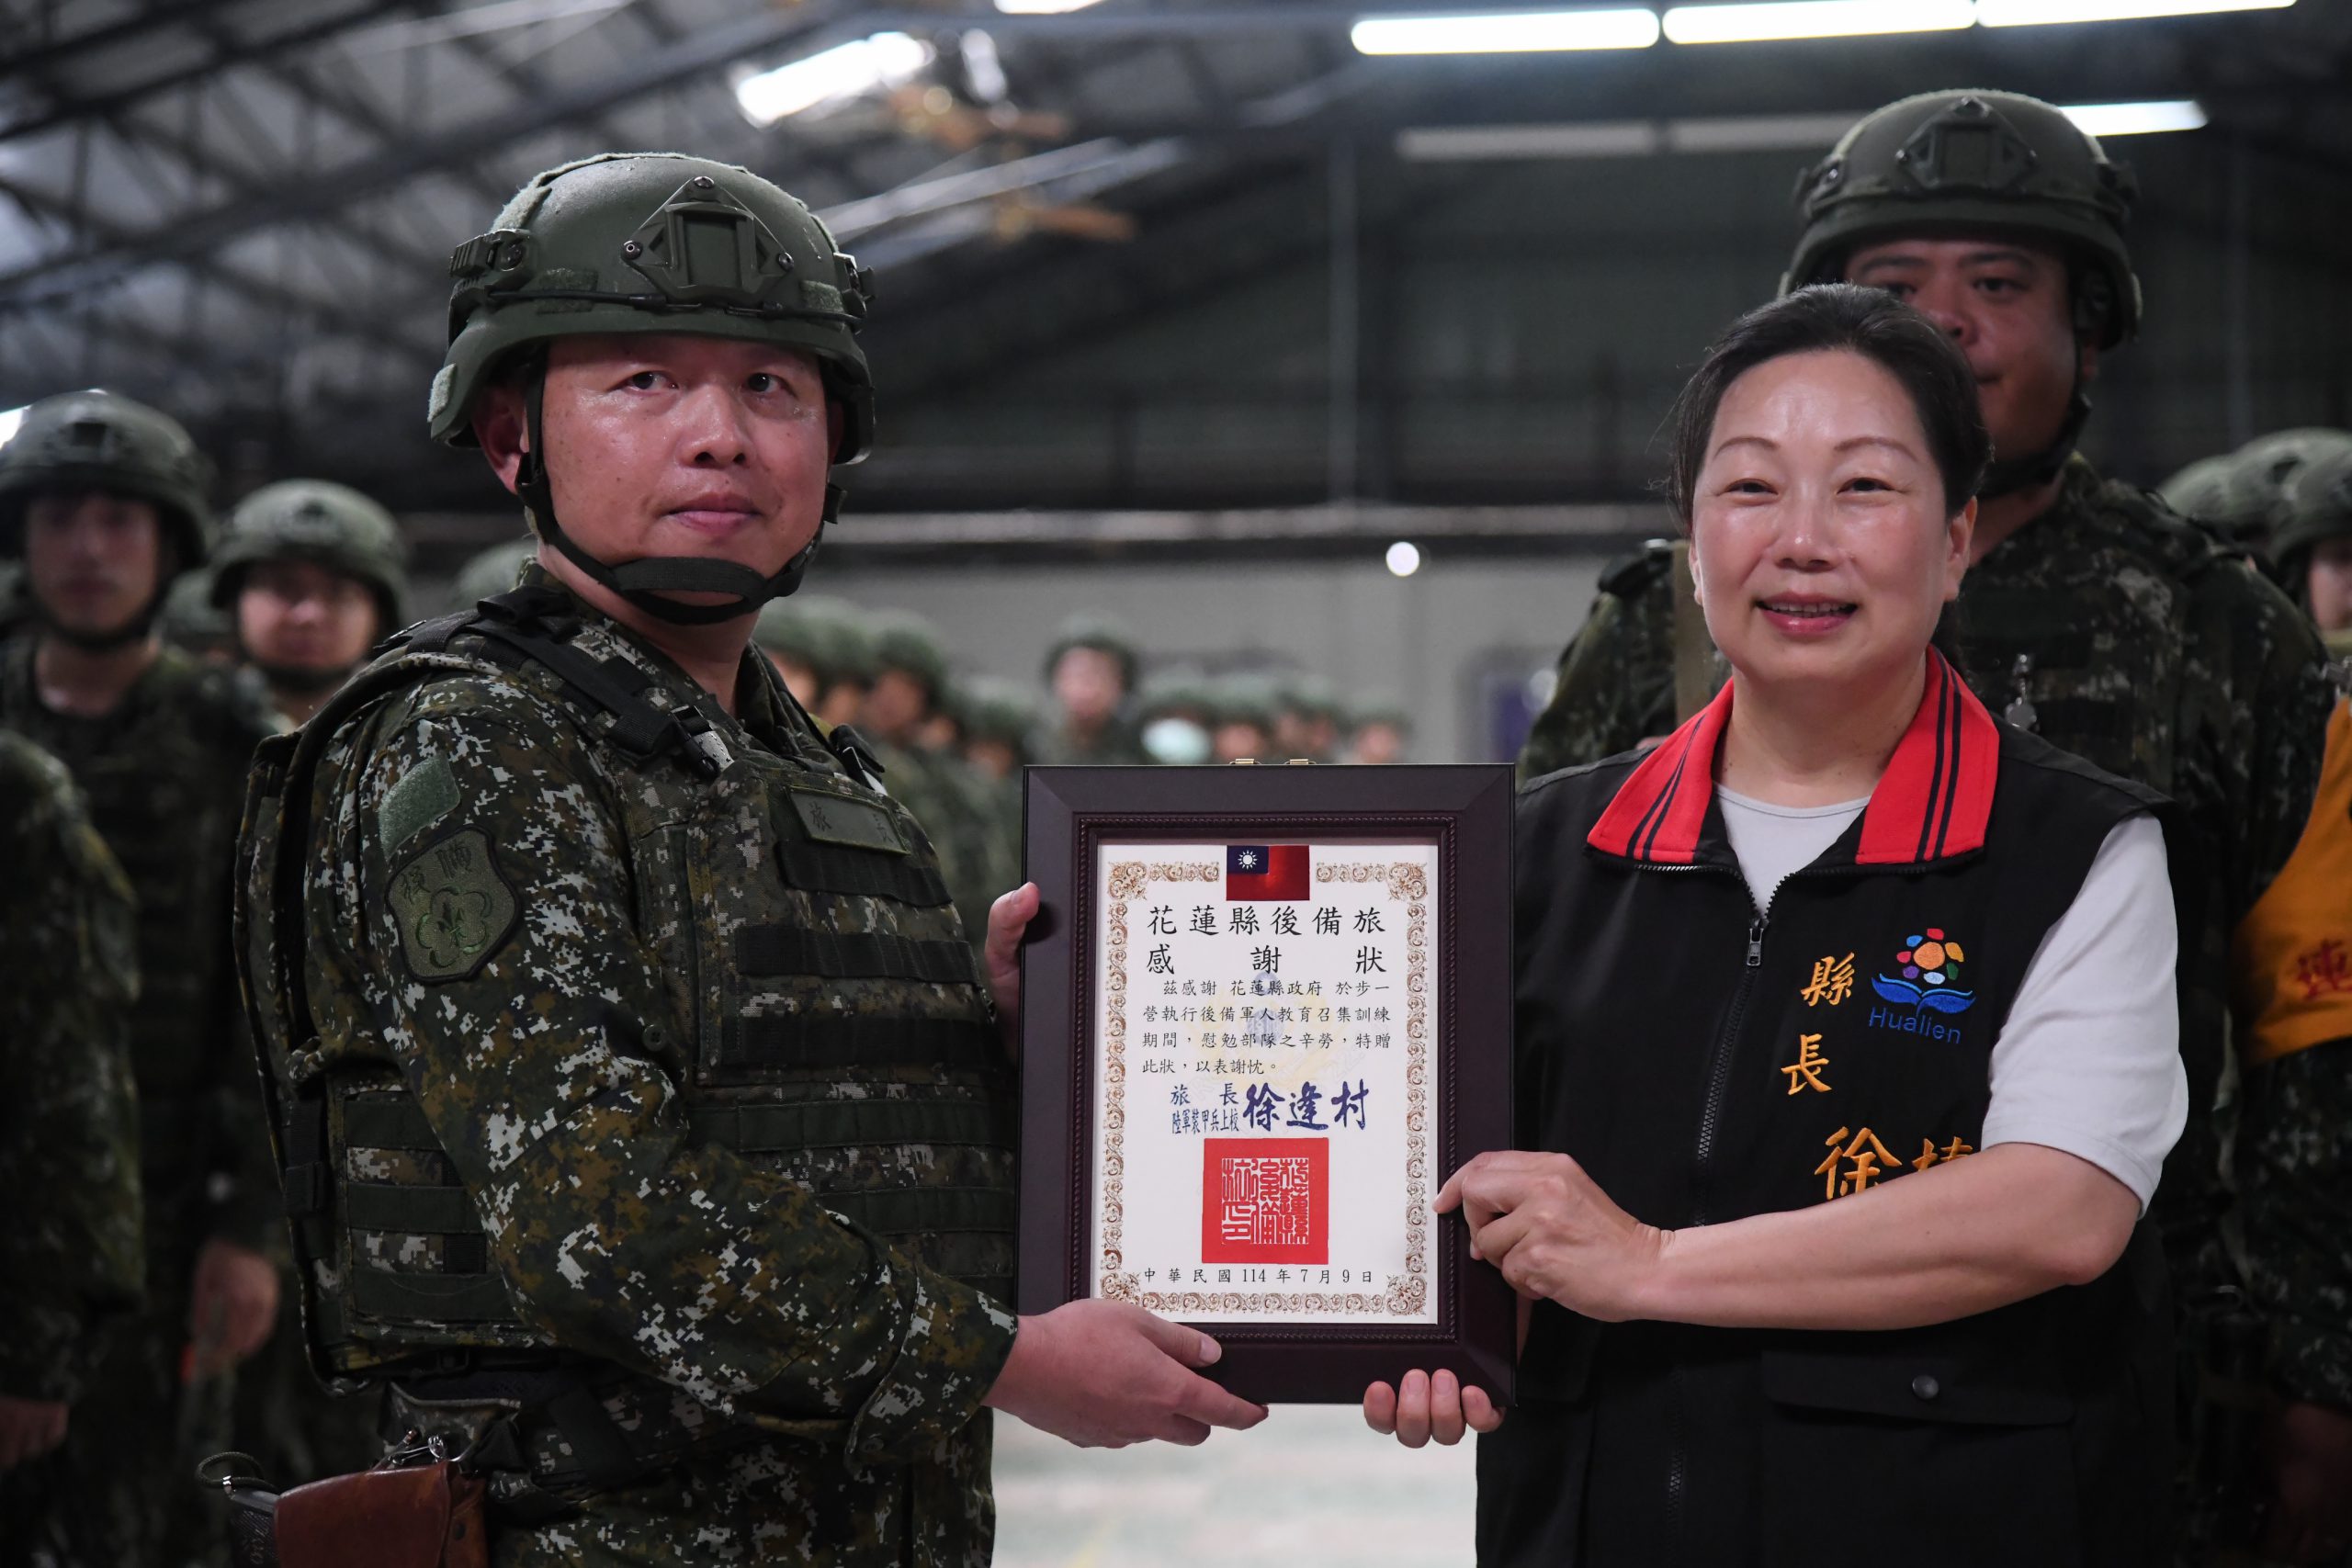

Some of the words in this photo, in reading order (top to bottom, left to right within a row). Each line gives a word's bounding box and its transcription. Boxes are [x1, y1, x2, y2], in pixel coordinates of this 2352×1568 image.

[1147, 904, 1386, 936] 花蓮縣後備旅
[1147, 943, 1387, 975] 感謝狀
[1162, 979, 1217, 996] 茲感謝
[1230, 979, 1323, 997] 花蓮縣政府
[1334, 979, 1391, 997] 於步一
[1142, 1005, 1391, 1023] 營執行後備軍人教育召集訓練
[1781, 952, 1856, 1096] 縣長
[1869, 1007, 1962, 1044] Hualien
[1170, 1082, 1239, 1106] 旅長
[1171, 1108, 1239, 1134] 陸軍裝甲兵上校
[1144, 1267, 1372, 1284] 中華民國114年7月9日
